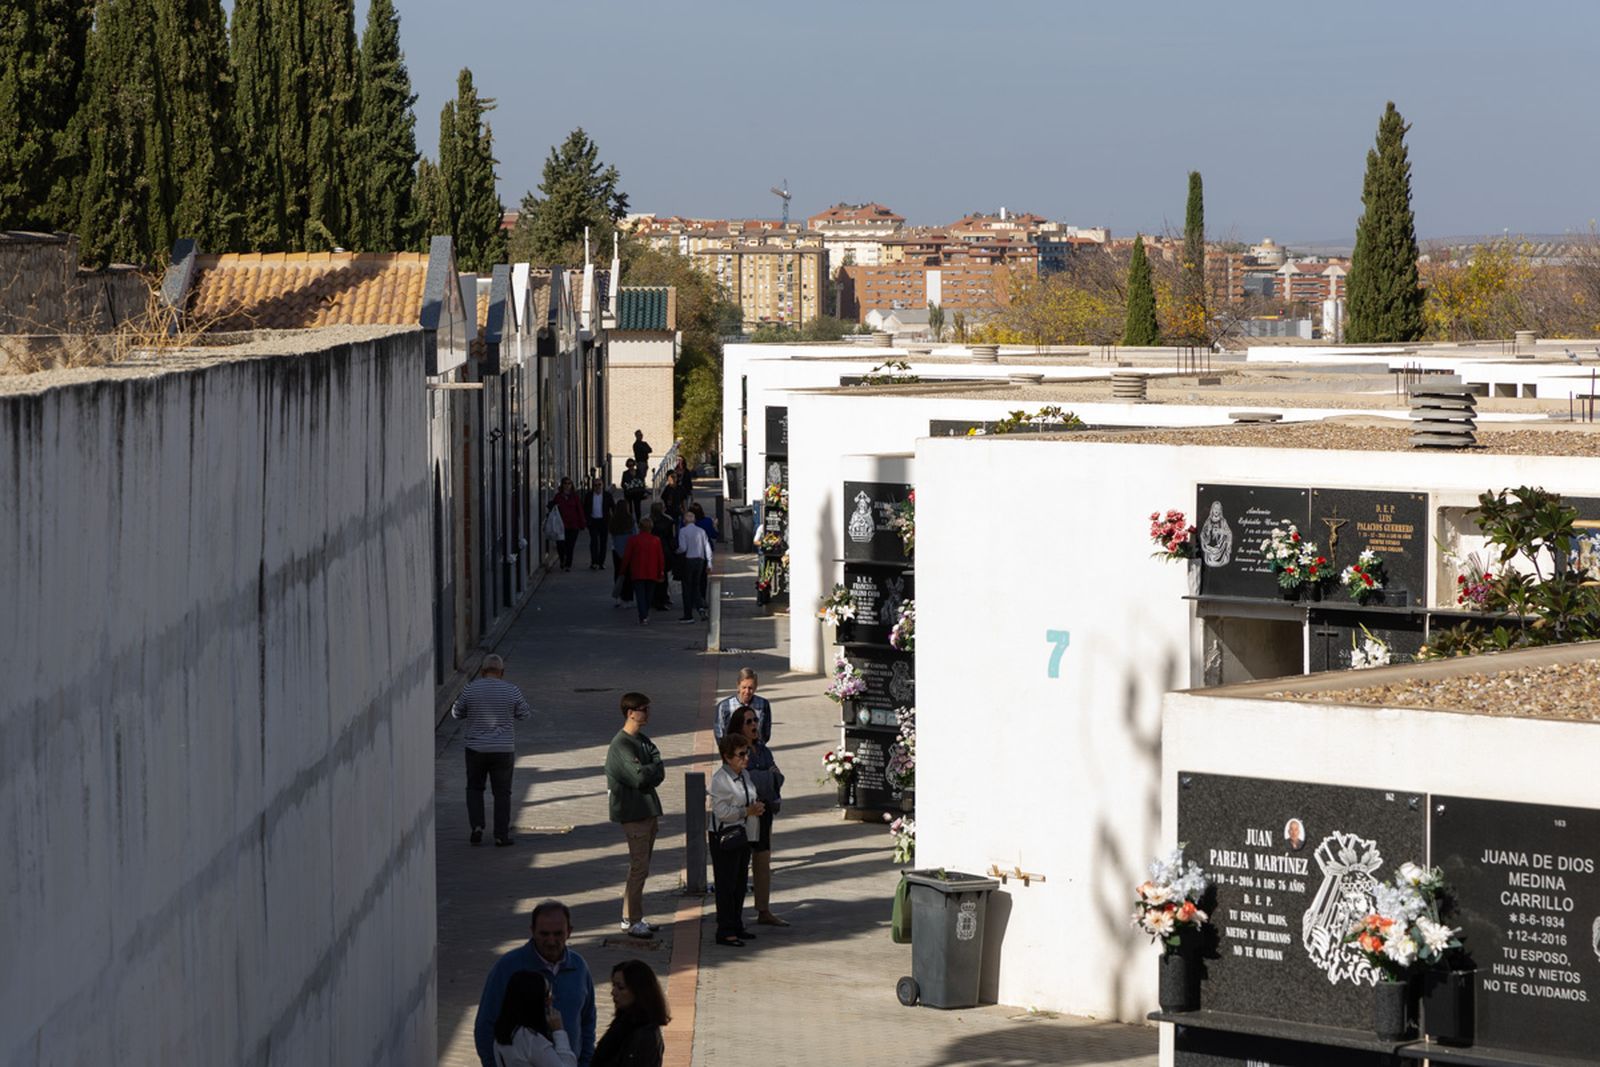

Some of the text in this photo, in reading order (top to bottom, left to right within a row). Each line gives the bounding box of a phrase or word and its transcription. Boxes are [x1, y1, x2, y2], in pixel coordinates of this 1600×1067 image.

[1046, 629, 1070, 678] 7
[1245, 828, 1273, 848] JUAN
[1210, 848, 1309, 876] PAREJA MARTÍNEZ
[1481, 848, 1594, 874] JUANA DE DIOS
[1256, 878, 1262, 888] A
[1264, 878, 1276, 890] LOS
[1288, 880, 1306, 894] AÑOS
[1509, 871, 1566, 891] MEDINA
[1244, 893, 1273, 907] D. E. P.
[1500, 890, 1574, 912] CARRILLO
[1229, 909, 1238, 921] TU
[1226, 926, 1292, 944] NIETOS Y HERMANOS
[1233, 944, 1284, 961] NO TE OLVIDAN
[1502, 946, 1518, 960] TU
[1493, 963, 1581, 984] HIJAS Y NIETOS
[1484, 980, 1590, 1002] NO TE OLVIDAMOS.
